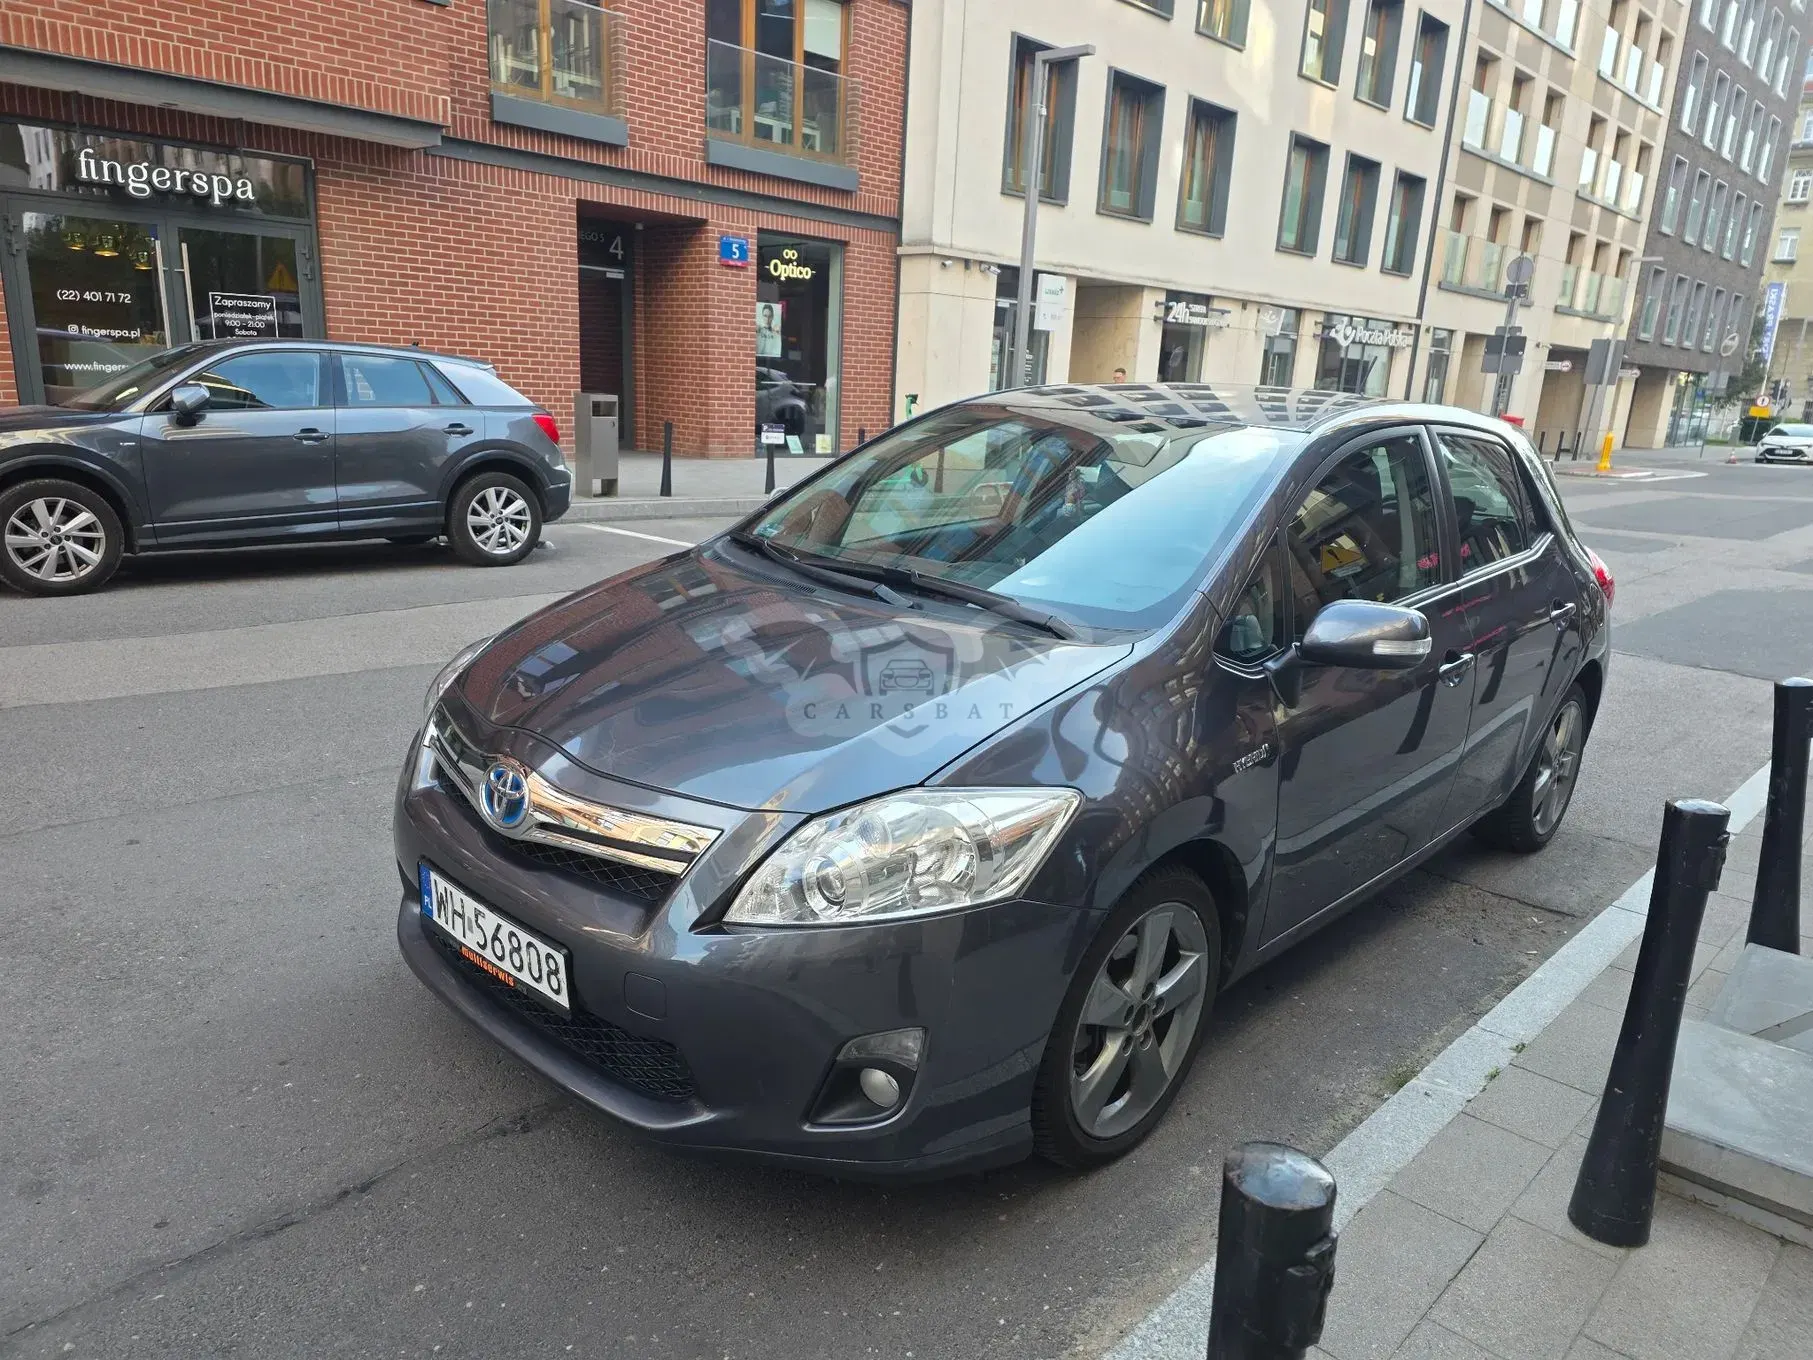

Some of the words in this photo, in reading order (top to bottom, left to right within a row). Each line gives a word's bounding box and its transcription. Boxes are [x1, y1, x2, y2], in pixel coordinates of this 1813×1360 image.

[78, 148, 255, 205] fingerspa
[609, 235, 624, 260] 4
[732, 243, 740, 259] 5
[770, 259, 812, 281] Optico
[57, 289, 81, 302] (22)
[83, 291, 103, 302] 401
[104, 292, 116, 303] 71
[117, 293, 132, 304] 72
[214, 295, 272, 310] Zapraszamy
[1167, 301, 1190, 324] 24h
[81, 325, 141, 339] fingerspa.pl
[234, 328, 258, 336] Sobota
[424, 895, 432, 909] PL
[434, 878, 467, 940] WH
[473, 907, 562, 996] 56808
